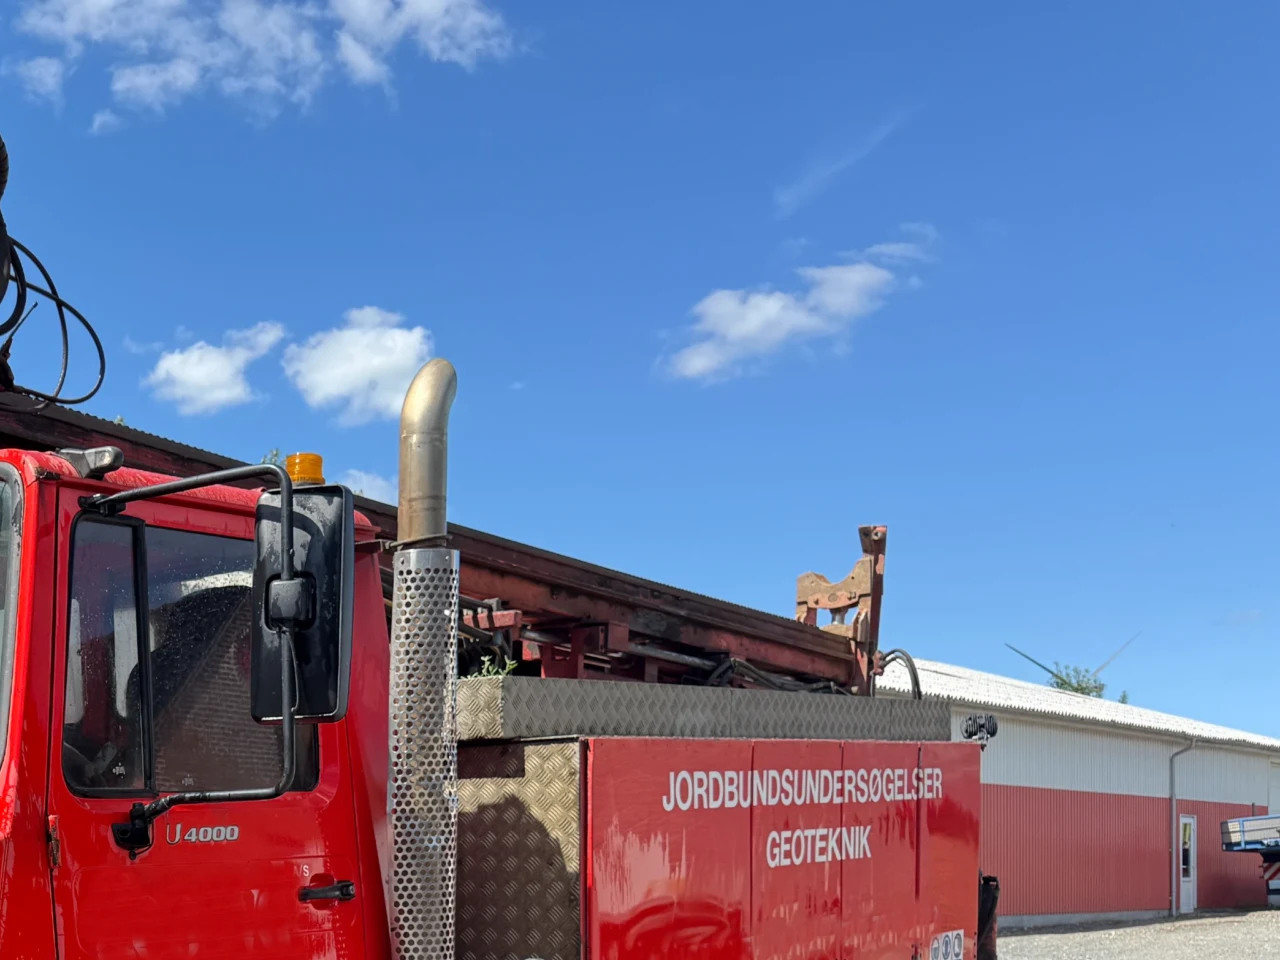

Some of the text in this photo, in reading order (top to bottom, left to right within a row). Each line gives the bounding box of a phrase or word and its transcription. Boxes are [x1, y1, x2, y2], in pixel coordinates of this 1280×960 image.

[662, 767, 943, 811] JORDBUNDSUNDERSØGELSER
[166, 823, 239, 845] U 4000
[766, 825, 871, 868] GEOTEKNIK
